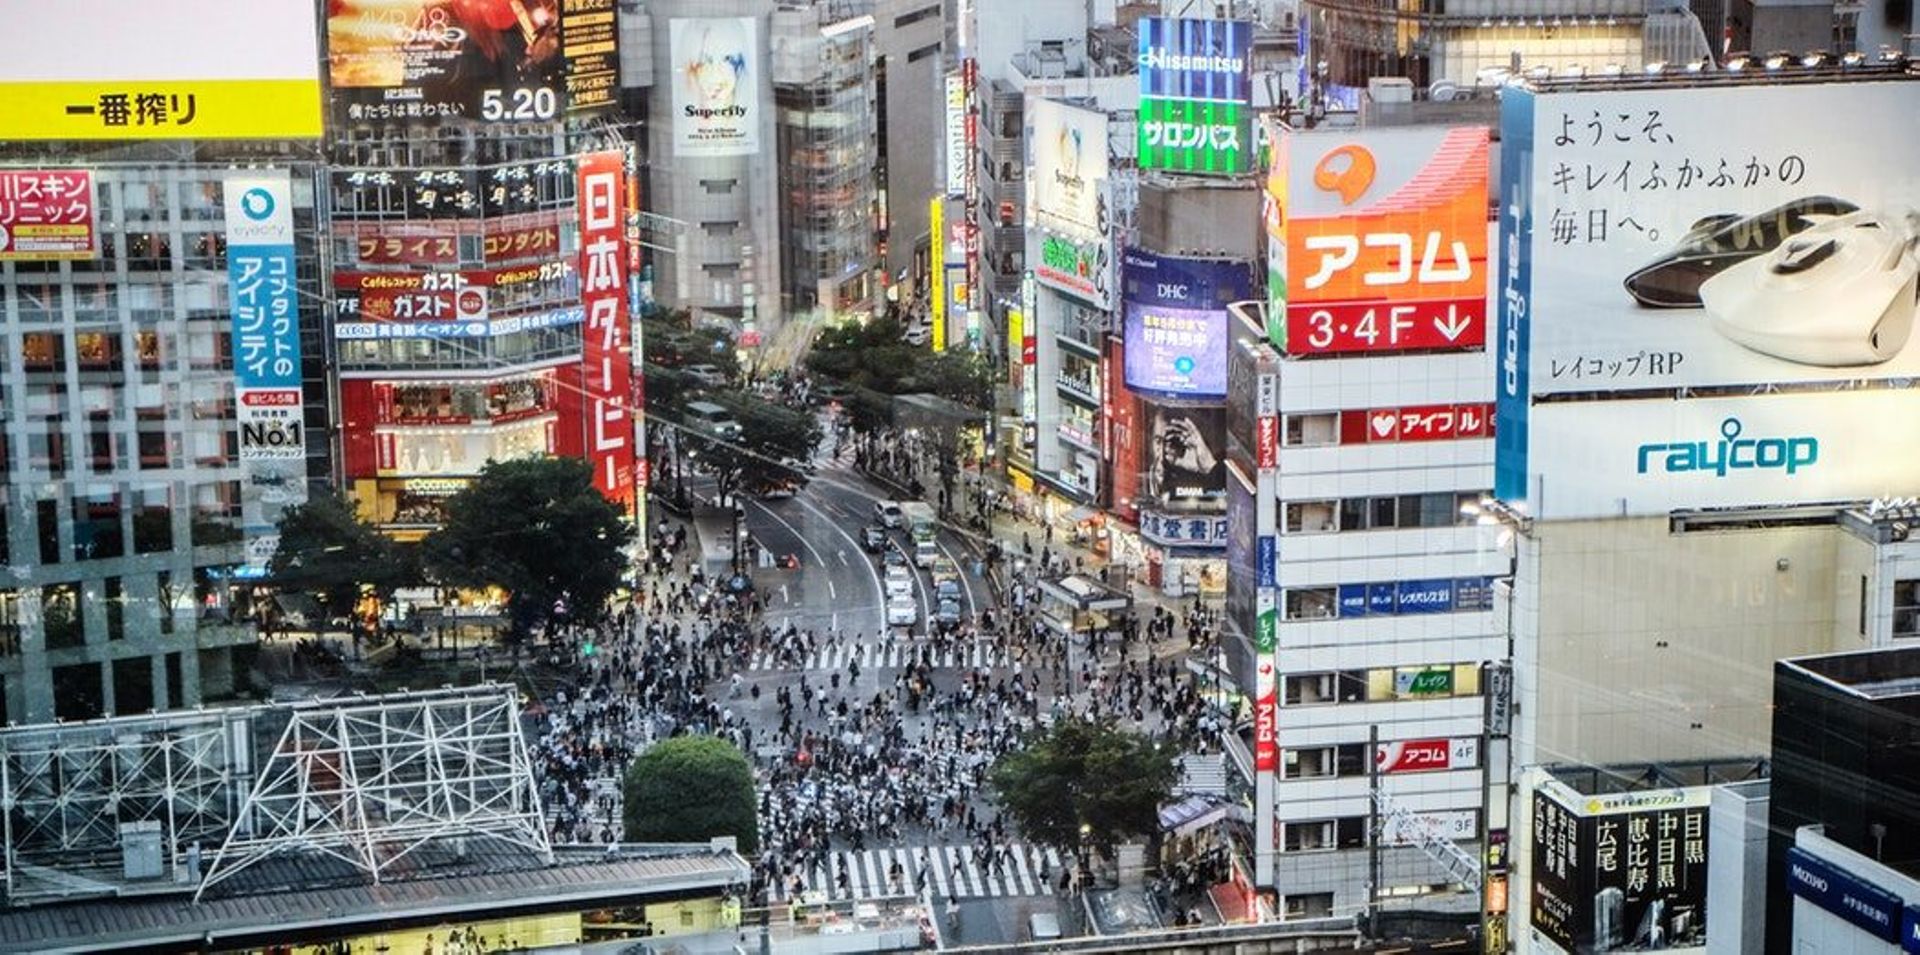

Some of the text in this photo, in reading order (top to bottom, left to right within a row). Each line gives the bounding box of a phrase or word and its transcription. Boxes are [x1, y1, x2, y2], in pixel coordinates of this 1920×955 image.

[1140, 47, 1242, 73] Hisamitsu
[66, 94, 196, 126] 一番搾り
[348, 102, 465, 119] 僕たちは戦わない
[481, 88, 555, 121] 5.20
[685, 104, 747, 119] Superfly
[1144, 121, 1240, 151] サロンパス
[1554, 110, 1676, 146] ようこそ、
[1552, 155, 1805, 193] キレイふかふかの
[485, 229, 557, 255] コンタクト
[1551, 207, 1660, 246] 毎日へ。
[359, 238, 455, 257] プライス
[1305, 231, 1473, 289] アコム
[423, 272, 468, 291] ガスト
[1157, 283, 1188, 299] DHC
[236, 257, 269, 377] アイシティ
[269, 256, 294, 376] コンタクトの
[337, 298, 359, 313] 7F
[394, 294, 451, 318] ガスト
[584, 172, 626, 491] 日本ダービー
[1551, 351, 1684, 379] レイコップRP
[243, 421, 300, 447] No.1
[1402, 412, 1480, 434] アイフル
[1637, 417, 1818, 477] raycop
[1259, 703, 1272, 742] アコム
[1404, 746, 1473, 764] アコム 4F
[1455, 818, 1472, 833] 3F
[1685, 813, 1705, 864] 目黒
[1598, 822, 1618, 872] 広尾
[1628, 817, 1650, 893] 恵比寿
[1657, 812, 1678, 888] 中目黒
